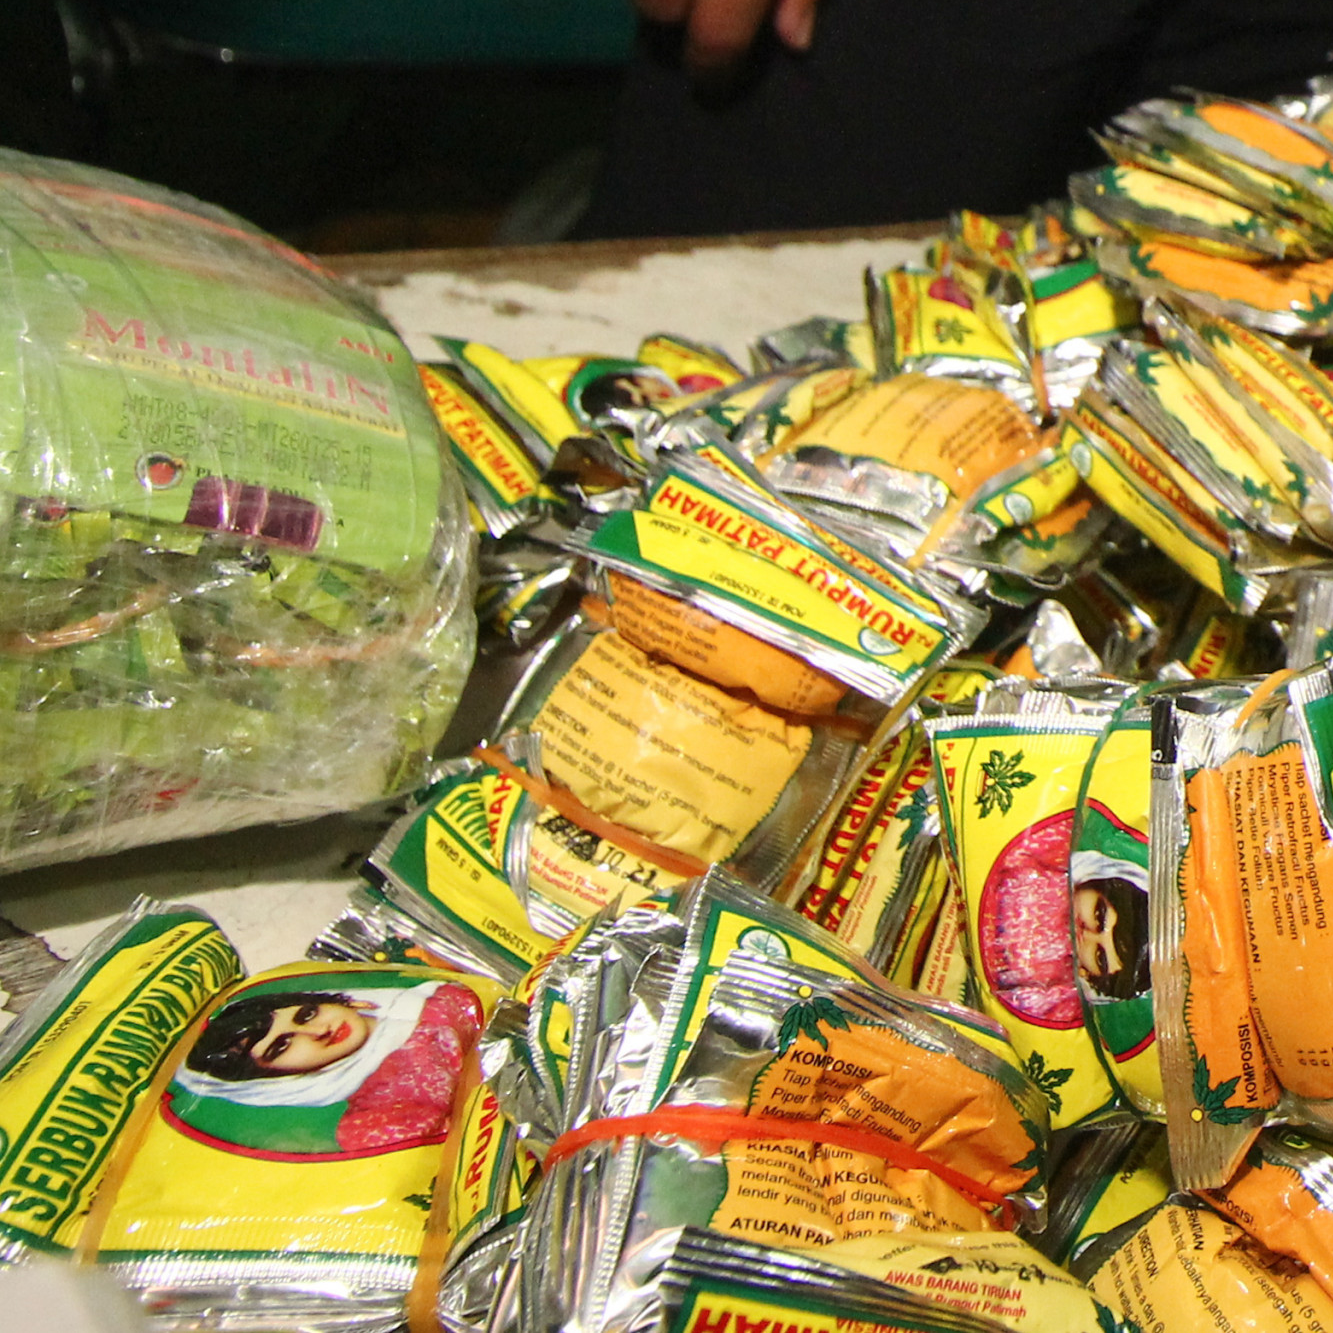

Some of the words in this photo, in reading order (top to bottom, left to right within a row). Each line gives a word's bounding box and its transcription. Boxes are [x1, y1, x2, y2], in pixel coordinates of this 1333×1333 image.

[658, 484, 785, 560] PATIMAH
[785, 557, 916, 646] RUMPUT
[1233, 769, 1244, 835] KHASIAT
[1299, 792, 1314, 840] sachet
[1237, 840, 1248, 874] DAN
[1279, 761, 1291, 798] Piper
[1296, 873, 1310, 926] Fructus
[1269, 885, 1284, 937] Fructus
[1303, 842, 1327, 931] mengandung
[483, 916, 535, 952] 153290401
[1241, 876, 1262, 964] KEGUNAAN
[925, 965, 938, 992] AWAS
[932, 924, 949, 965] BARANG
[1237, 1022, 1259, 1104] KOMPOSISI
[770, 1086, 809, 1105] Piper
[782, 1068, 811, 1086] Tiap
[852, 1081, 924, 1134] mengandung
[1, 1084, 124, 1223] SERBUK
[729, 1217, 802, 1240] ATURAN
[736, 1185, 780, 1202] lendir
[783, 1193, 817, 1214] yang
[1136, 1228, 1158, 1280] DIRECTION
[884, 1270, 923, 1287] AWAS
[926, 1276, 979, 1295] BARANG
[981, 1279, 1022, 1302] TIRUAN
[1141, 1304, 1159, 1325] day
